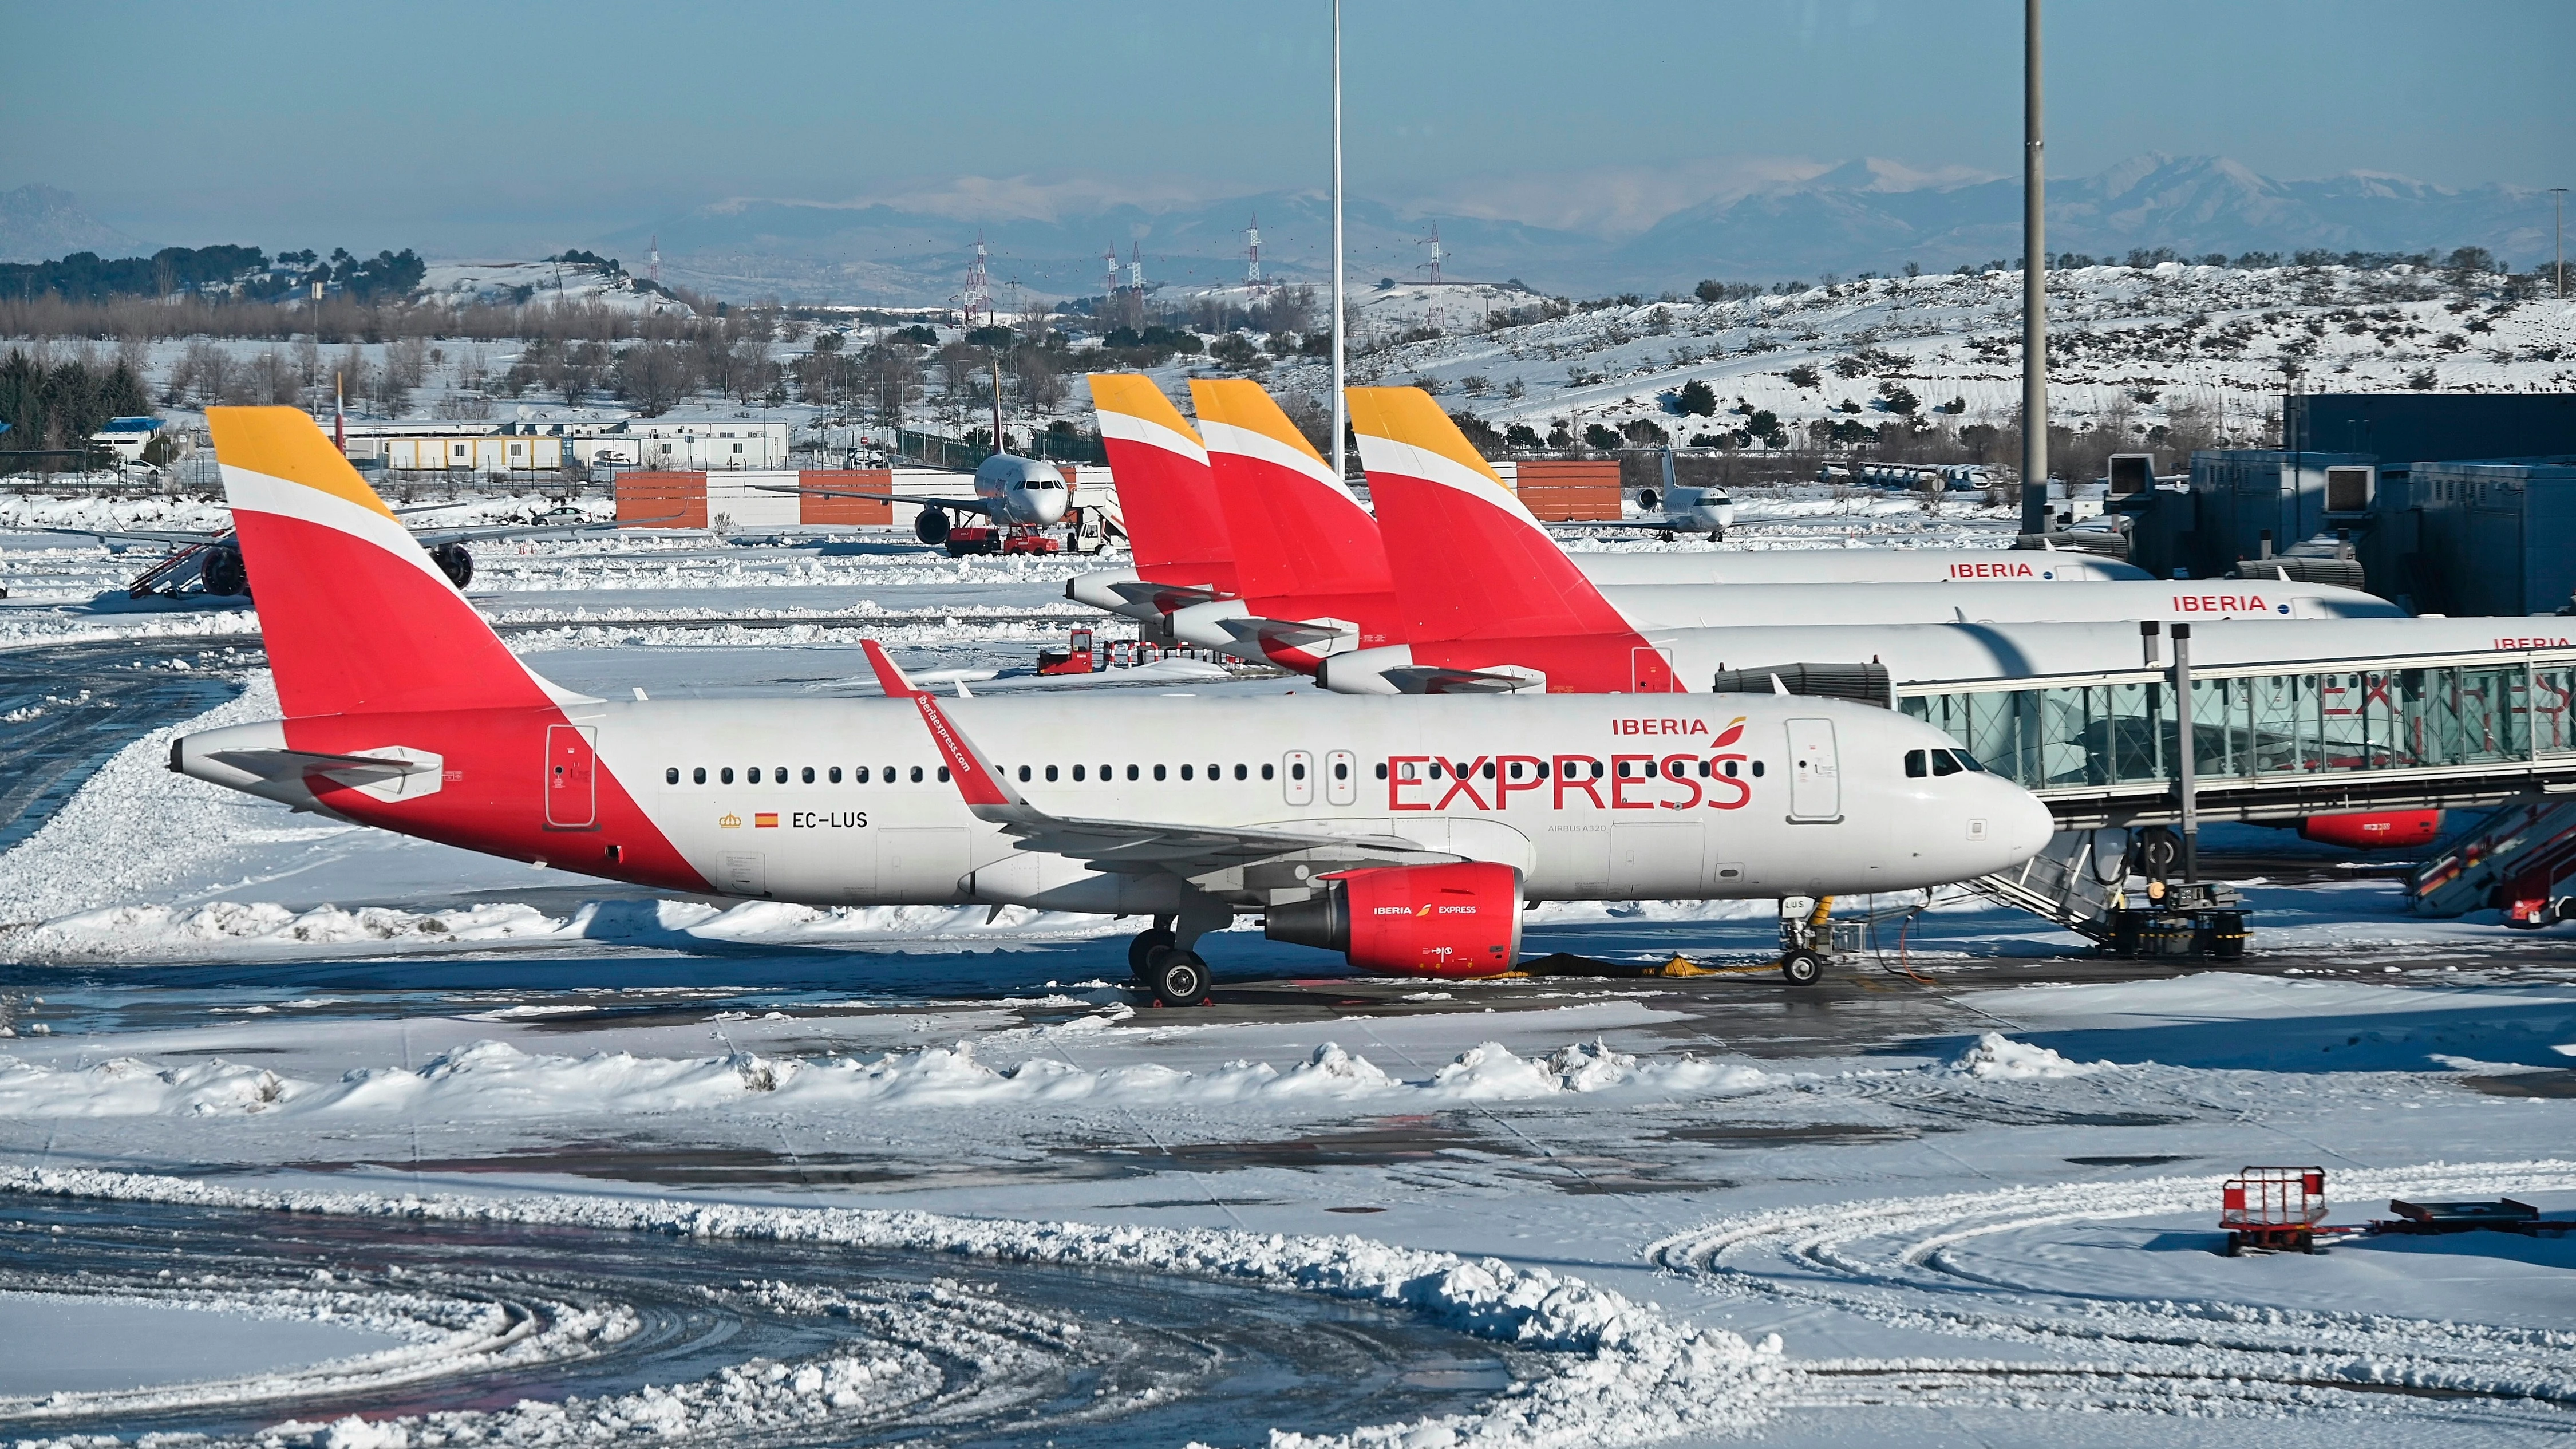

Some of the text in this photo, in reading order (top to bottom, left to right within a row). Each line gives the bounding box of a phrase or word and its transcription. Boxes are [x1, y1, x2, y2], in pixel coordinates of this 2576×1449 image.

[1950, 563, 2033, 578] IBERIA
[2174, 595, 2267, 612] IBERIA
[918, 695, 971, 772] iberiaexpress.com
[1613, 718, 1709, 735] IBERIA
[1388, 753, 1752, 811] EXPRESS
[792, 811, 868, 828] EC-LUS
[1374, 907, 1412, 915] IBERIA
[1786, 900, 1804, 908] LUS
